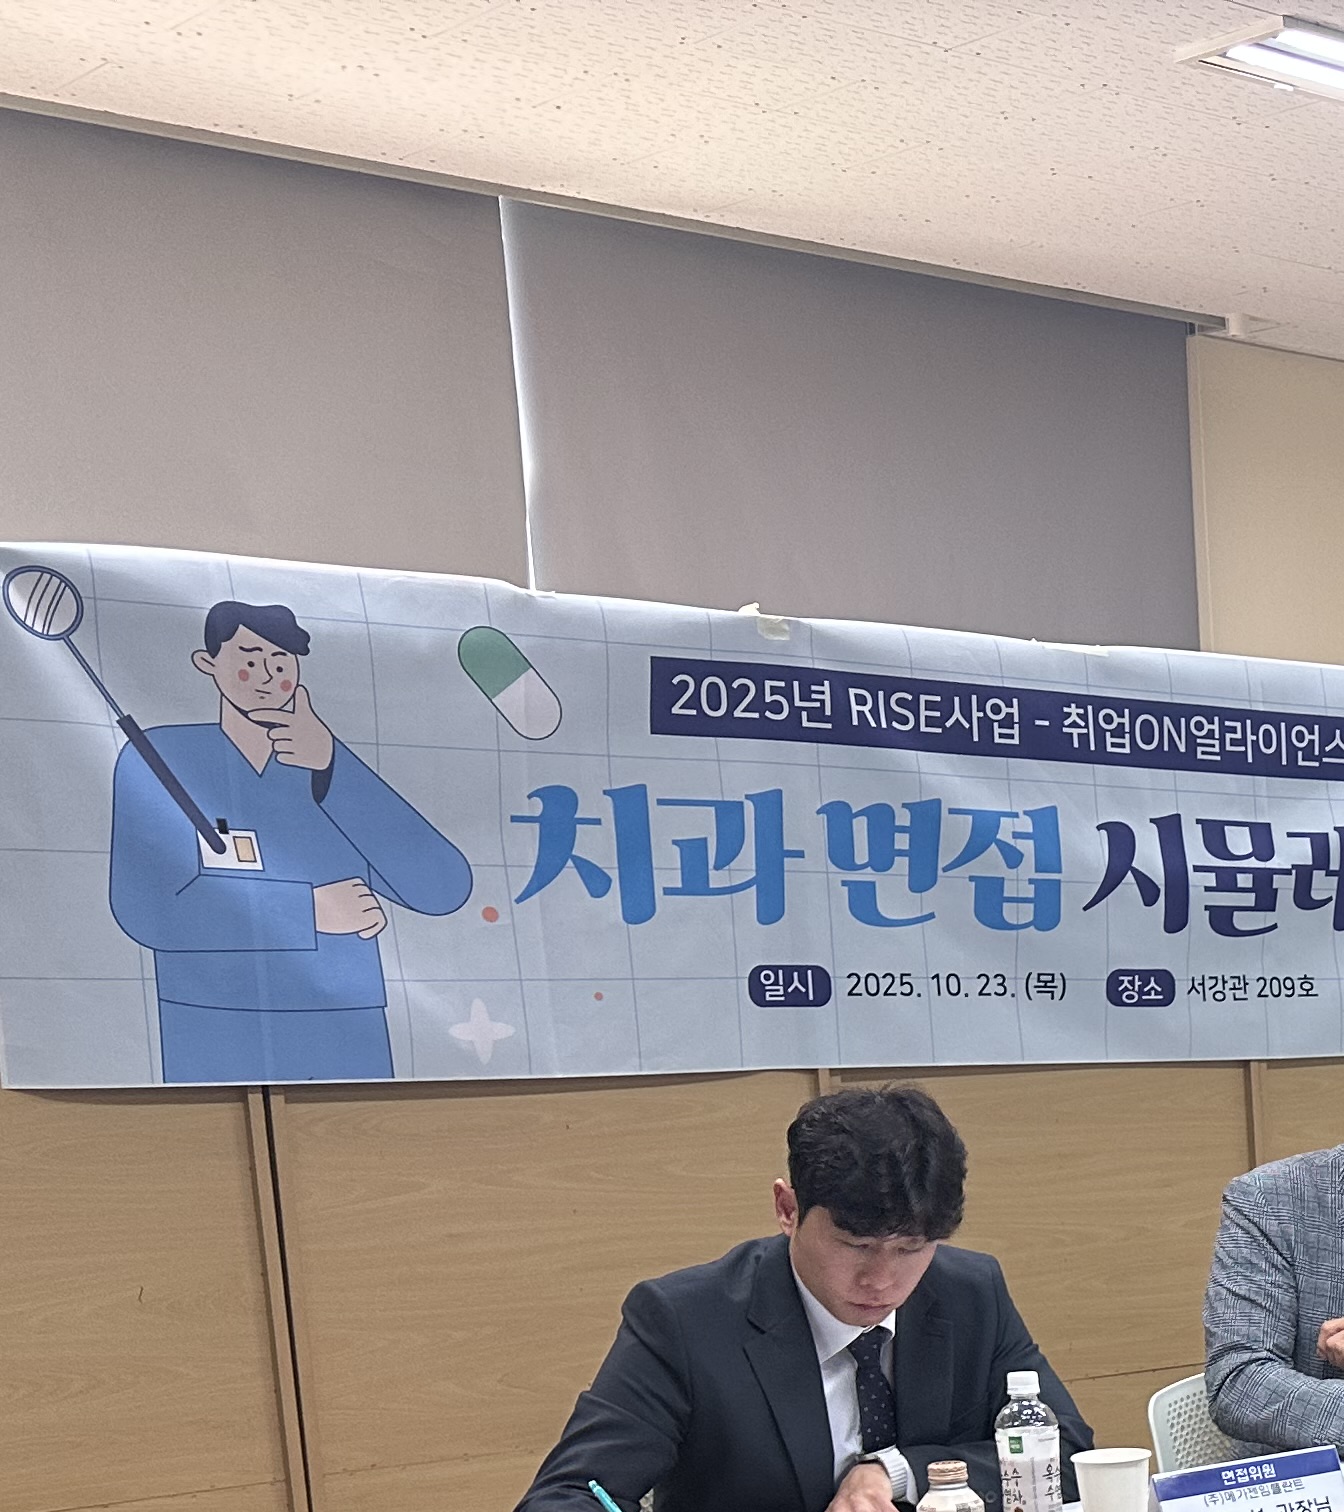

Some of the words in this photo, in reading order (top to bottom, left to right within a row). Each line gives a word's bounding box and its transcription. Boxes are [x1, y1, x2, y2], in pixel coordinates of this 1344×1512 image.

[670, 673, 833, 731] 2025년
[848, 686, 1021, 745] RISE사업
[509, 783, 806, 927] 치과
[815, 796, 1064, 933] 면접
[759, 969, 815, 1001] 일시
[846, 972, 922, 998] 2025.
[930, 973, 970, 999] 10.
[976, 973, 1016, 999] 23.
[1024, 971, 1067, 1001] (목)
[1117, 975, 1165, 1003] 장소
[1187, 974, 1250, 1002] 서강관
[1256, 974, 1319, 999] 209호
[1220, 1463, 1277, 1486] 면접위원
